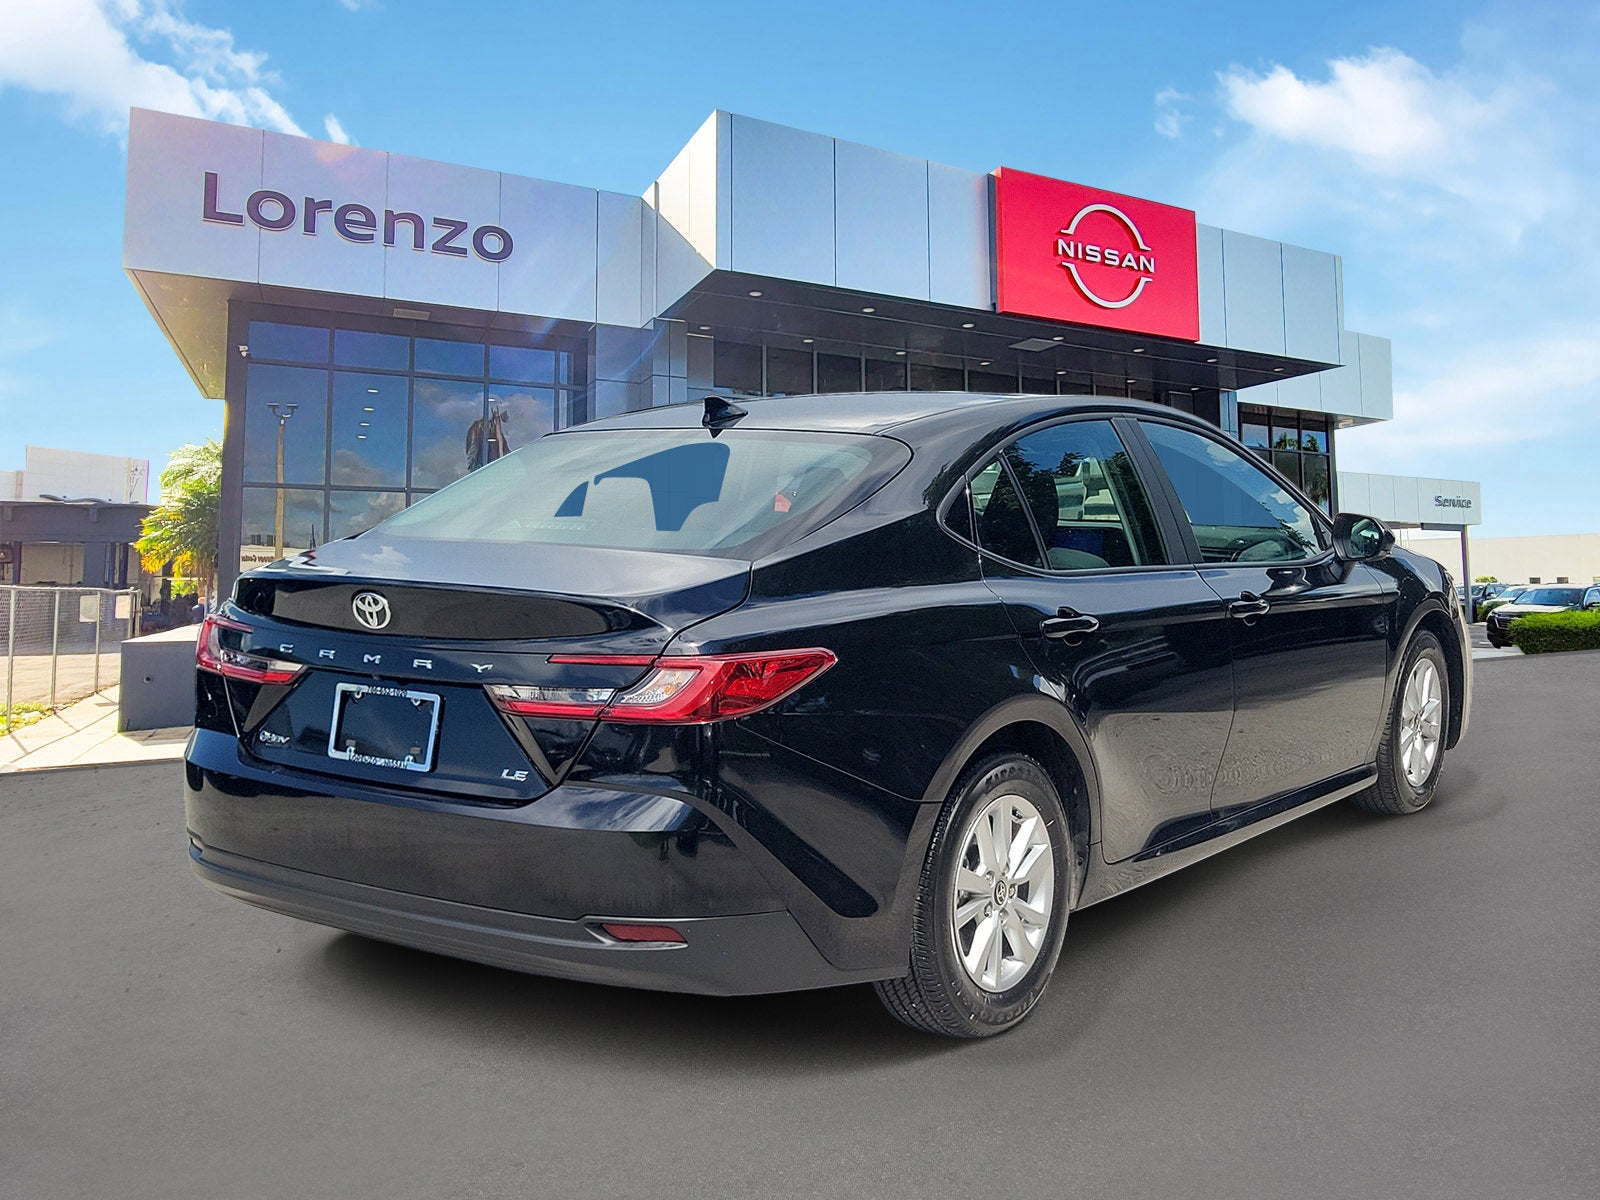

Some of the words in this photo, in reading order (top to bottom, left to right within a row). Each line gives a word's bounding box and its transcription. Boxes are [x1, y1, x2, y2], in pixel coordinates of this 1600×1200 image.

[203, 171, 515, 263] Lorenzo
[1057, 238, 1156, 273] NISSAN
[1434, 495, 1472, 509] Service
[279, 643, 494, 673] CAMRY
[500, 768, 530, 782] LE
